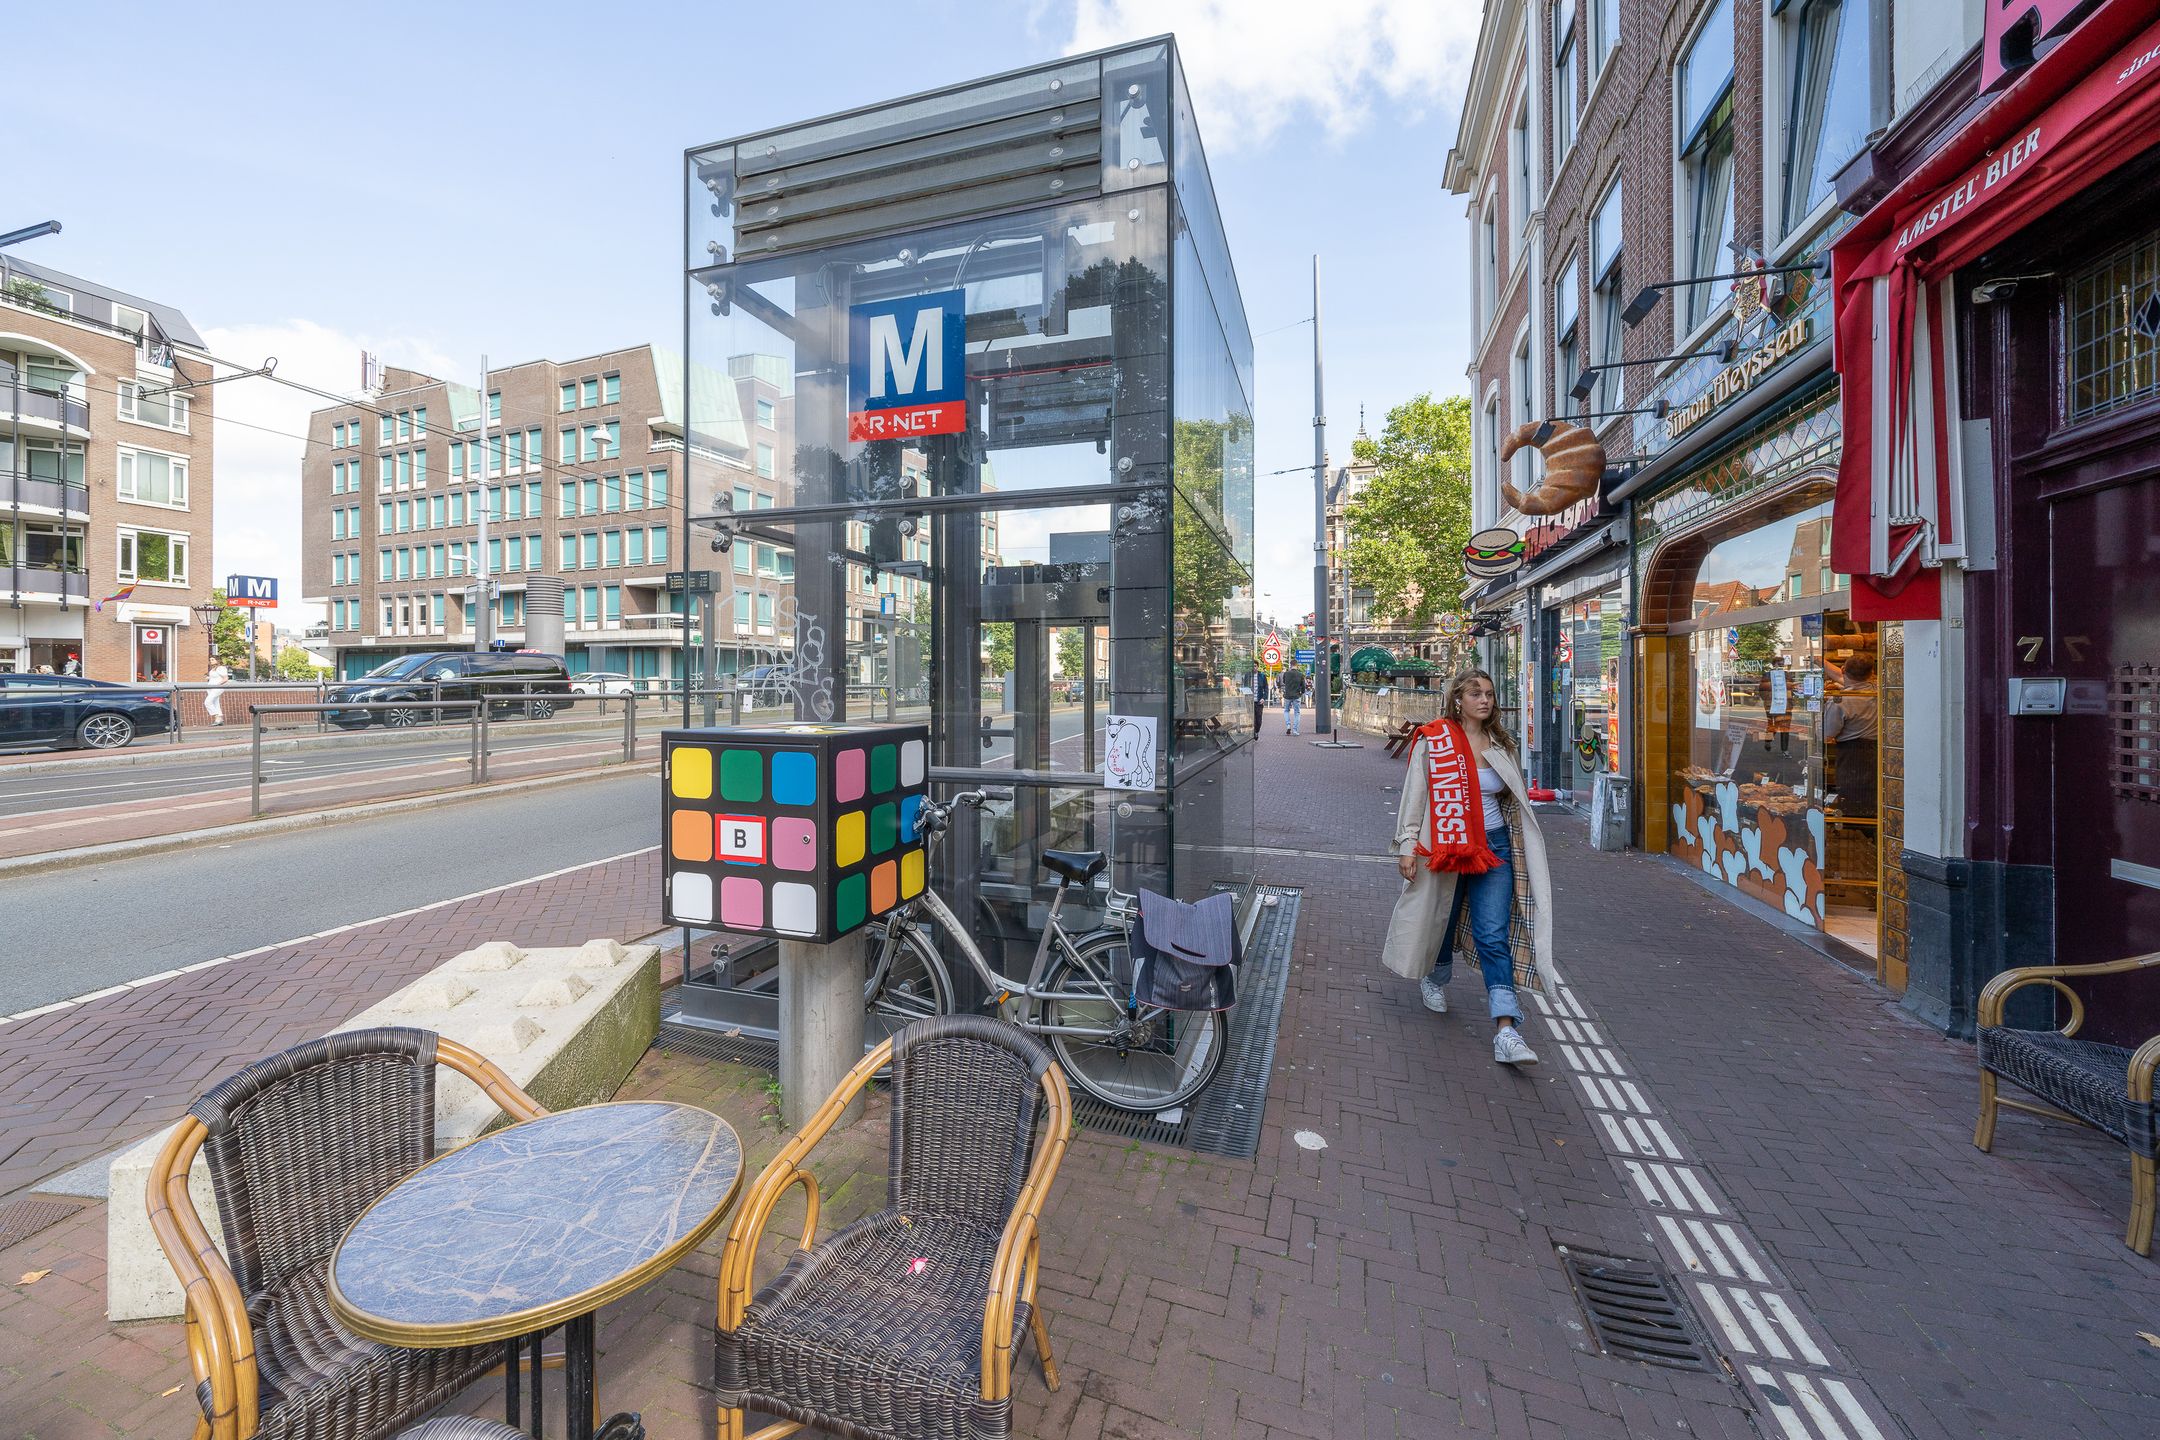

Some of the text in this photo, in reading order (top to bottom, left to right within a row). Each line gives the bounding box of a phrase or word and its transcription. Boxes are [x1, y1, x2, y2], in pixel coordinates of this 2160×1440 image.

[1894, 127, 2041, 253] AMSTEL BIER
[870, 307, 943, 398] M
[1665, 392, 1711, 441] Simon
[229, 578, 239, 597] M
[247, 578, 272, 598] M
[2017, 636, 2044, 662] 7
[1428, 724, 1468, 844] ESSENTIEL
[734, 828, 747, 849] B
